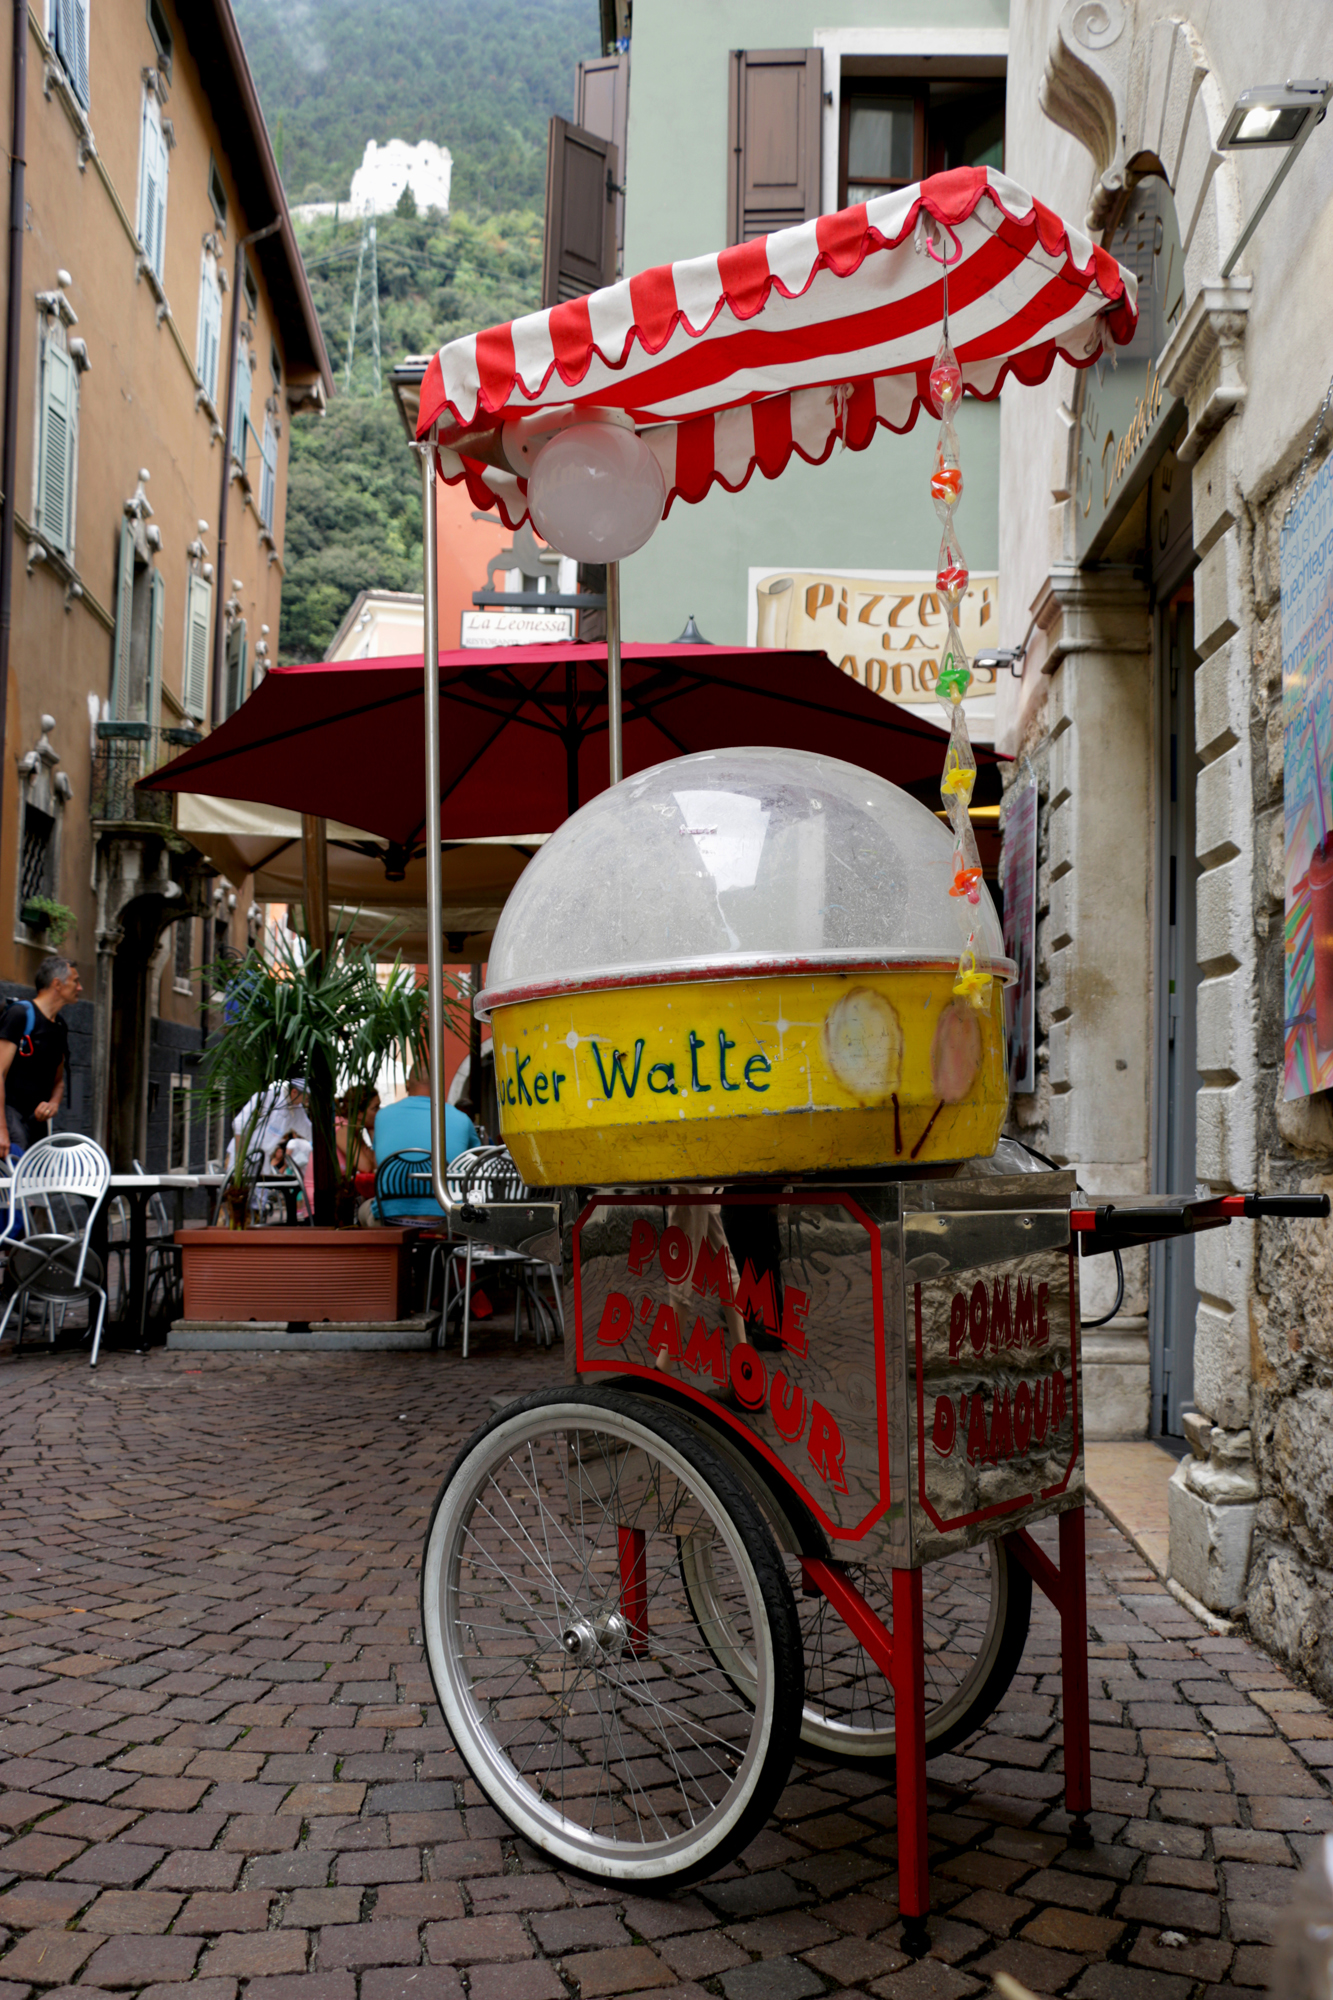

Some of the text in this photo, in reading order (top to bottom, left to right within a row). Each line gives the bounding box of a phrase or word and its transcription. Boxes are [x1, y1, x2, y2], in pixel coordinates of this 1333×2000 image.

[467, 613, 567, 632] La Leonessa
[591, 1028, 773, 1099] Watte
[627, 1218, 811, 1361] POMME
[949, 1273, 1050, 1366] POMME
[597, 1292, 850, 1496] D'AMOUR
[932, 1370, 1068, 1469] D'AMOUR
